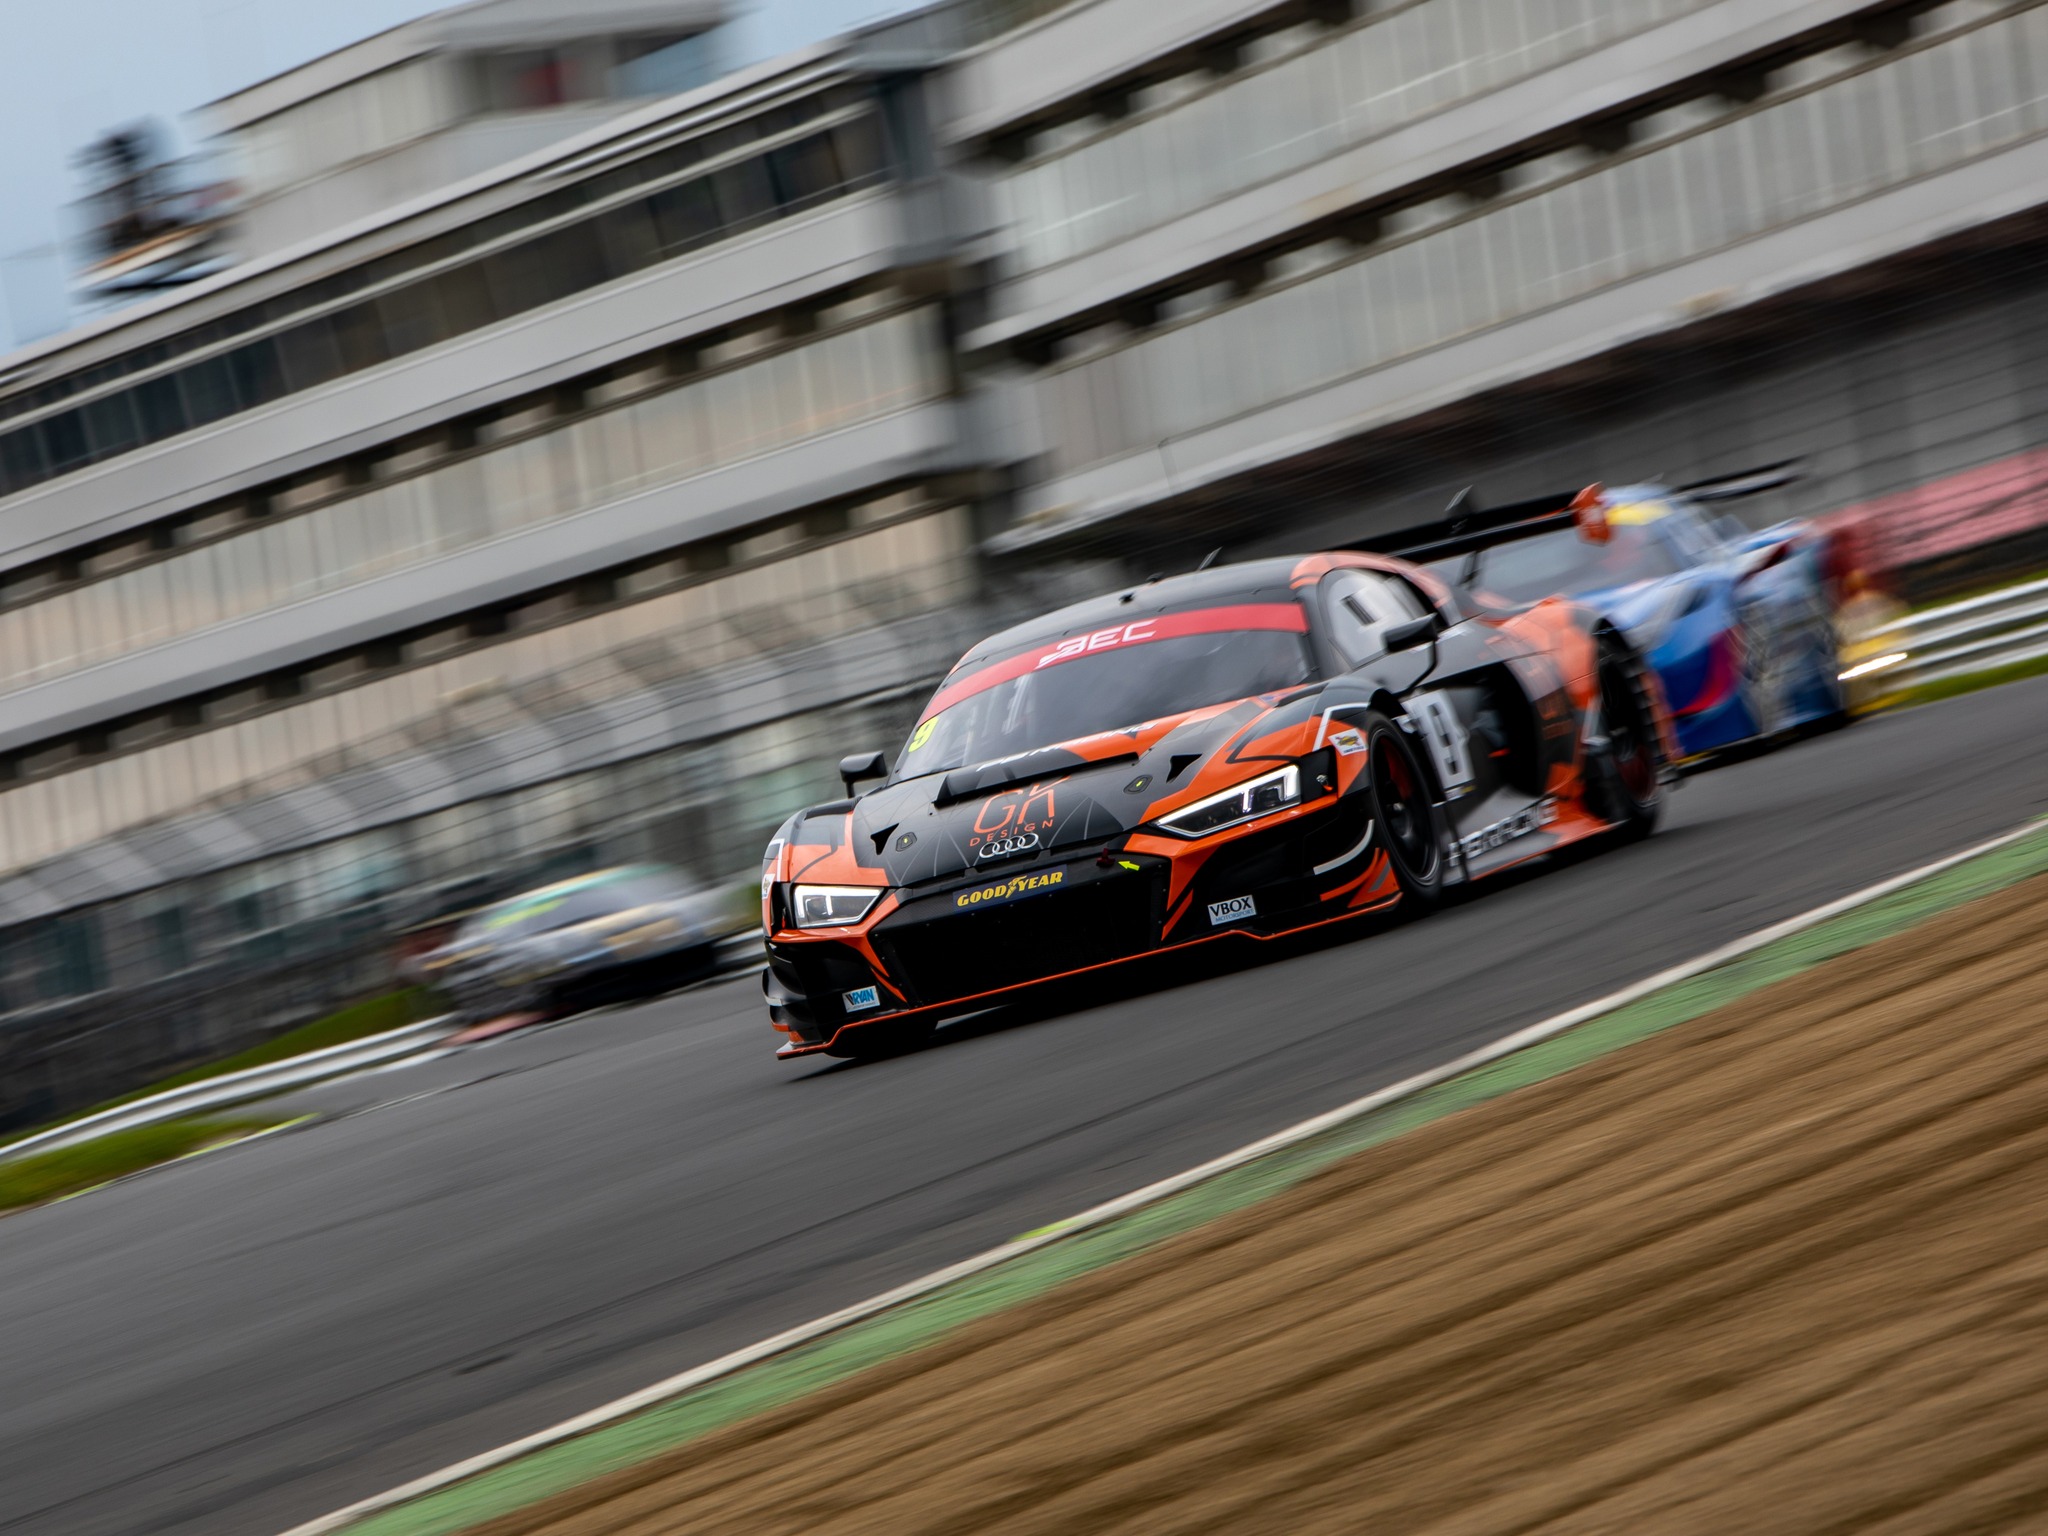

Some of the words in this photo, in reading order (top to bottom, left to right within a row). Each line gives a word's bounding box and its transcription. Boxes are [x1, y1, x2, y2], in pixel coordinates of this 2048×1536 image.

[908, 715, 939, 753] 9
[969, 819, 1054, 848] DESIGN
[1209, 896, 1252, 917] VBOX
[852, 988, 876, 1006] RYAN
